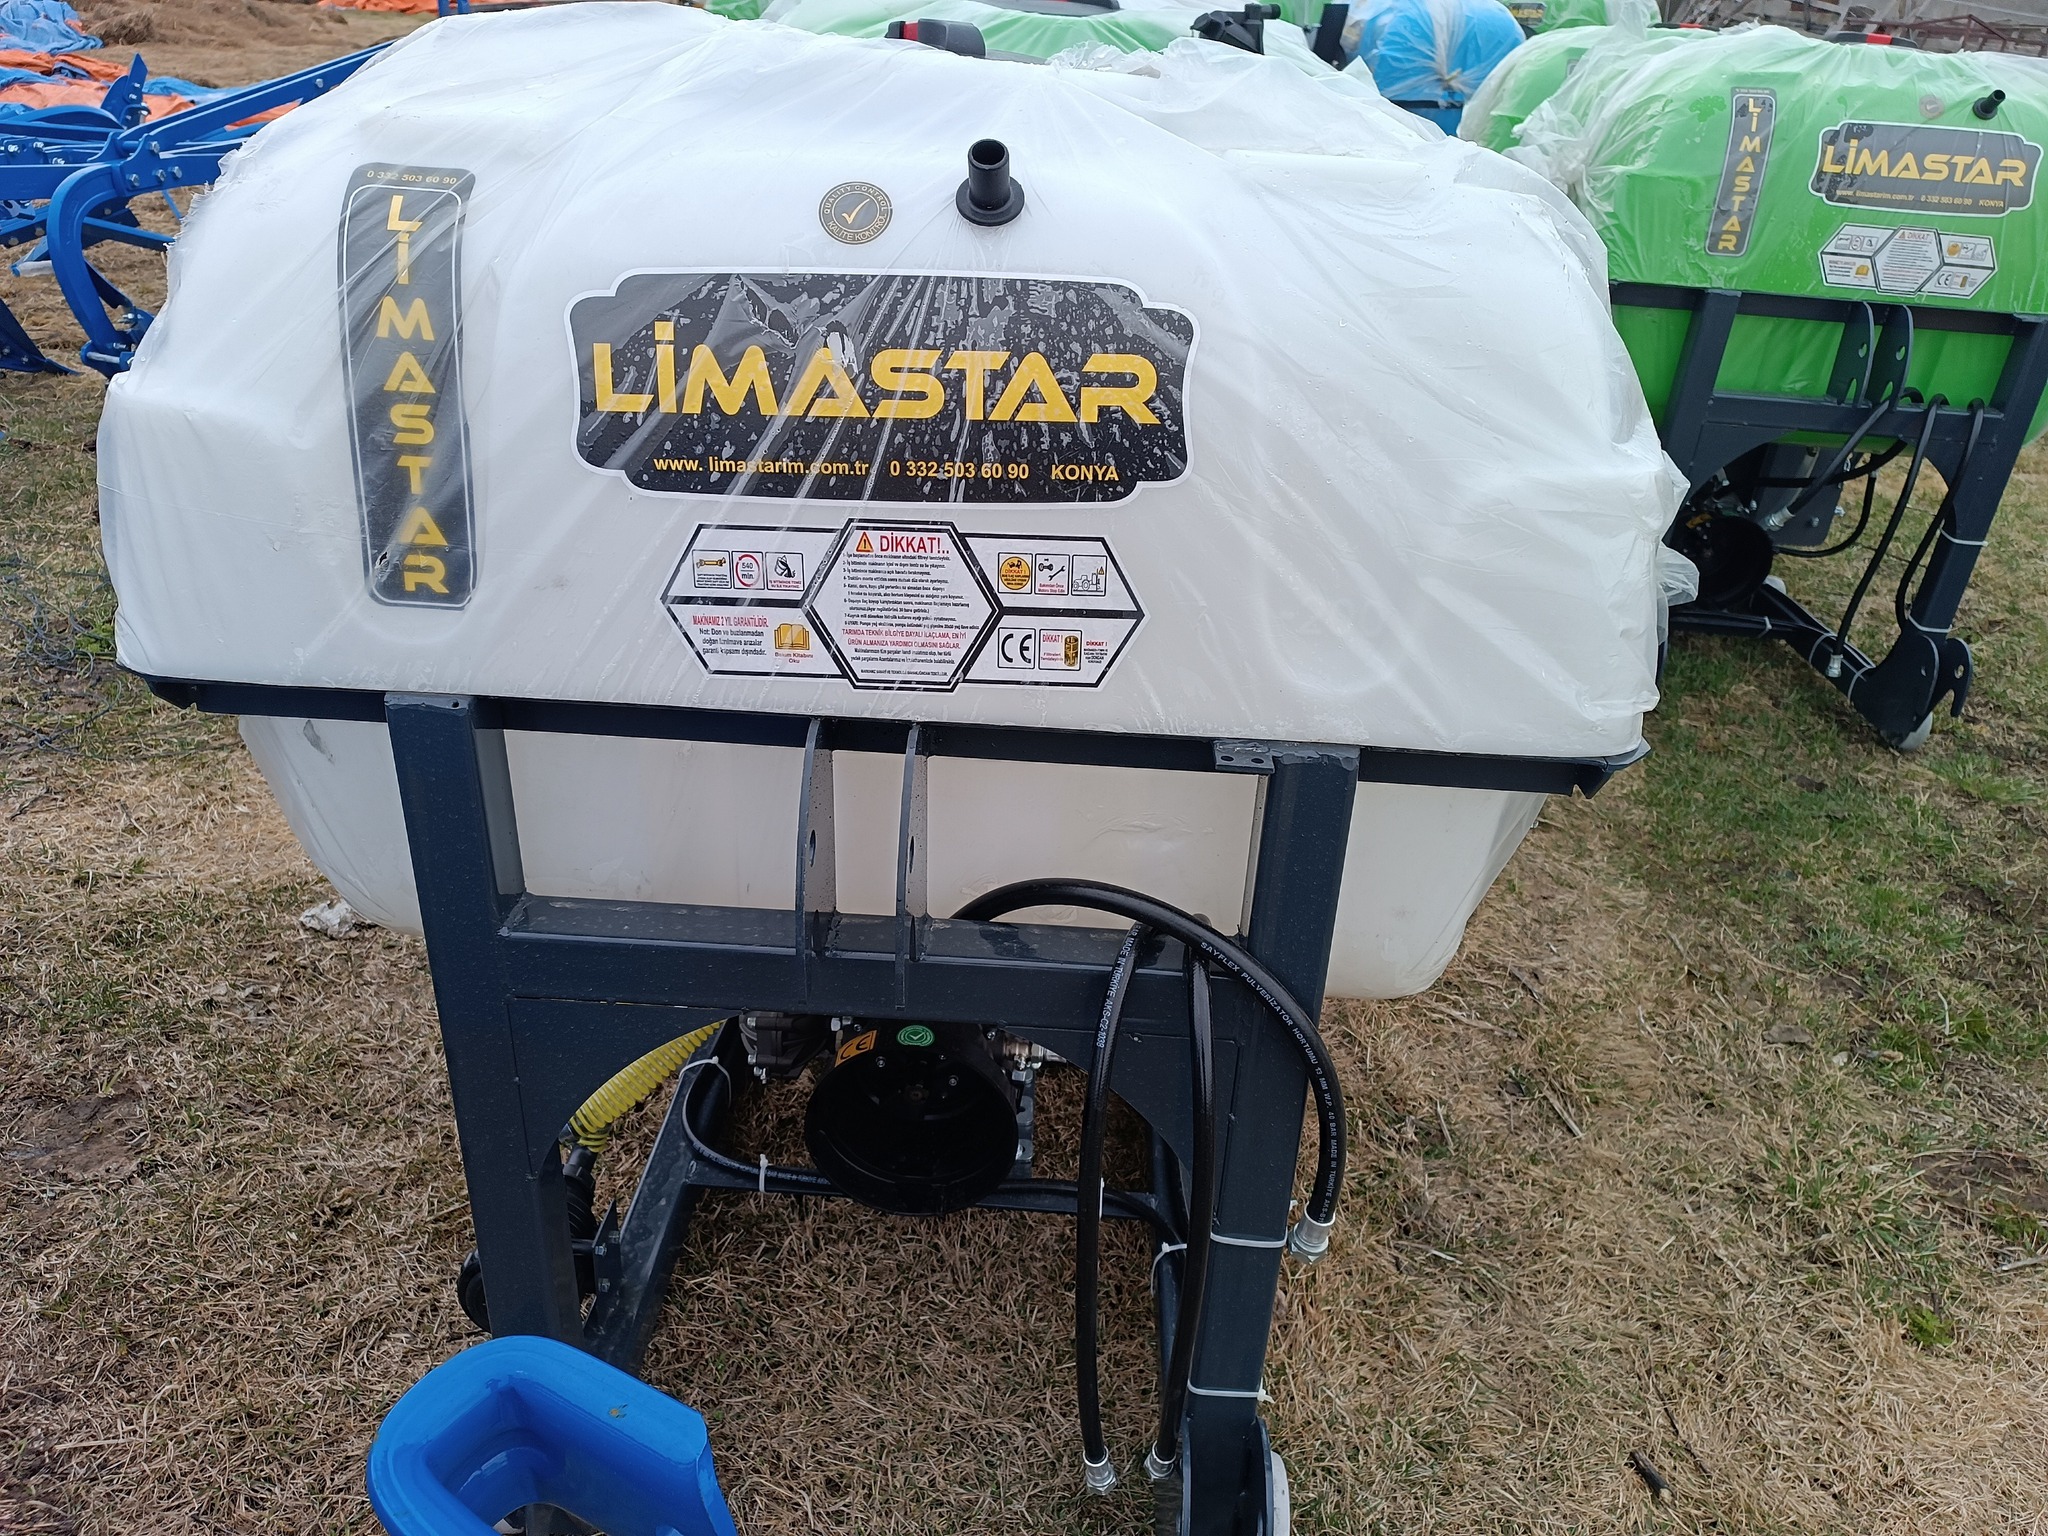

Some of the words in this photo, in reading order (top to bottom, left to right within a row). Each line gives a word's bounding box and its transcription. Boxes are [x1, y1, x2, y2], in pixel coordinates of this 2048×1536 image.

[1822, 139, 2027, 186] LİMASTAR
[367, 170, 374, 178] 0
[377, 171, 398, 180] 332
[401, 174, 422, 182] 503
[425, 175, 440, 184] 60
[442, 176, 457, 185] 90
[824, 185, 851, 214] QUALITY
[854, 185, 888, 212] CONTROL
[854, 214, 887, 241] KONTROL
[592, 320, 1161, 424] LİMASTAR
[377, 195, 449, 594] LİMASTAR
[653, 457, 703, 472] www.
[708, 456, 868, 476] limastarim.com.tr
[890, 461, 900, 476] 0
[906, 461, 942, 477] 332
[944, 461, 976, 478] 503
[980, 463, 1002, 479] 60
[1008, 463, 1030, 480] 90
[1051, 464, 1120, 482] KONYA
[741, 562, 754, 570] 540
[1120, 936, 1134, 957] MADE
[1200, 942, 1240, 972] SAYFLEX
[1106, 964, 1124, 998] TÜRKİYE
[1292, 1027, 1318, 1065] HORTUMU
[1319, 1077, 1328, 1090] MM
[1324, 1092, 1333, 1109] W.P.
[1328, 1112, 1334, 1120] 40
[1330, 1140, 1338, 1159] MADE
[1330, 1160, 1337, 1168] IN
